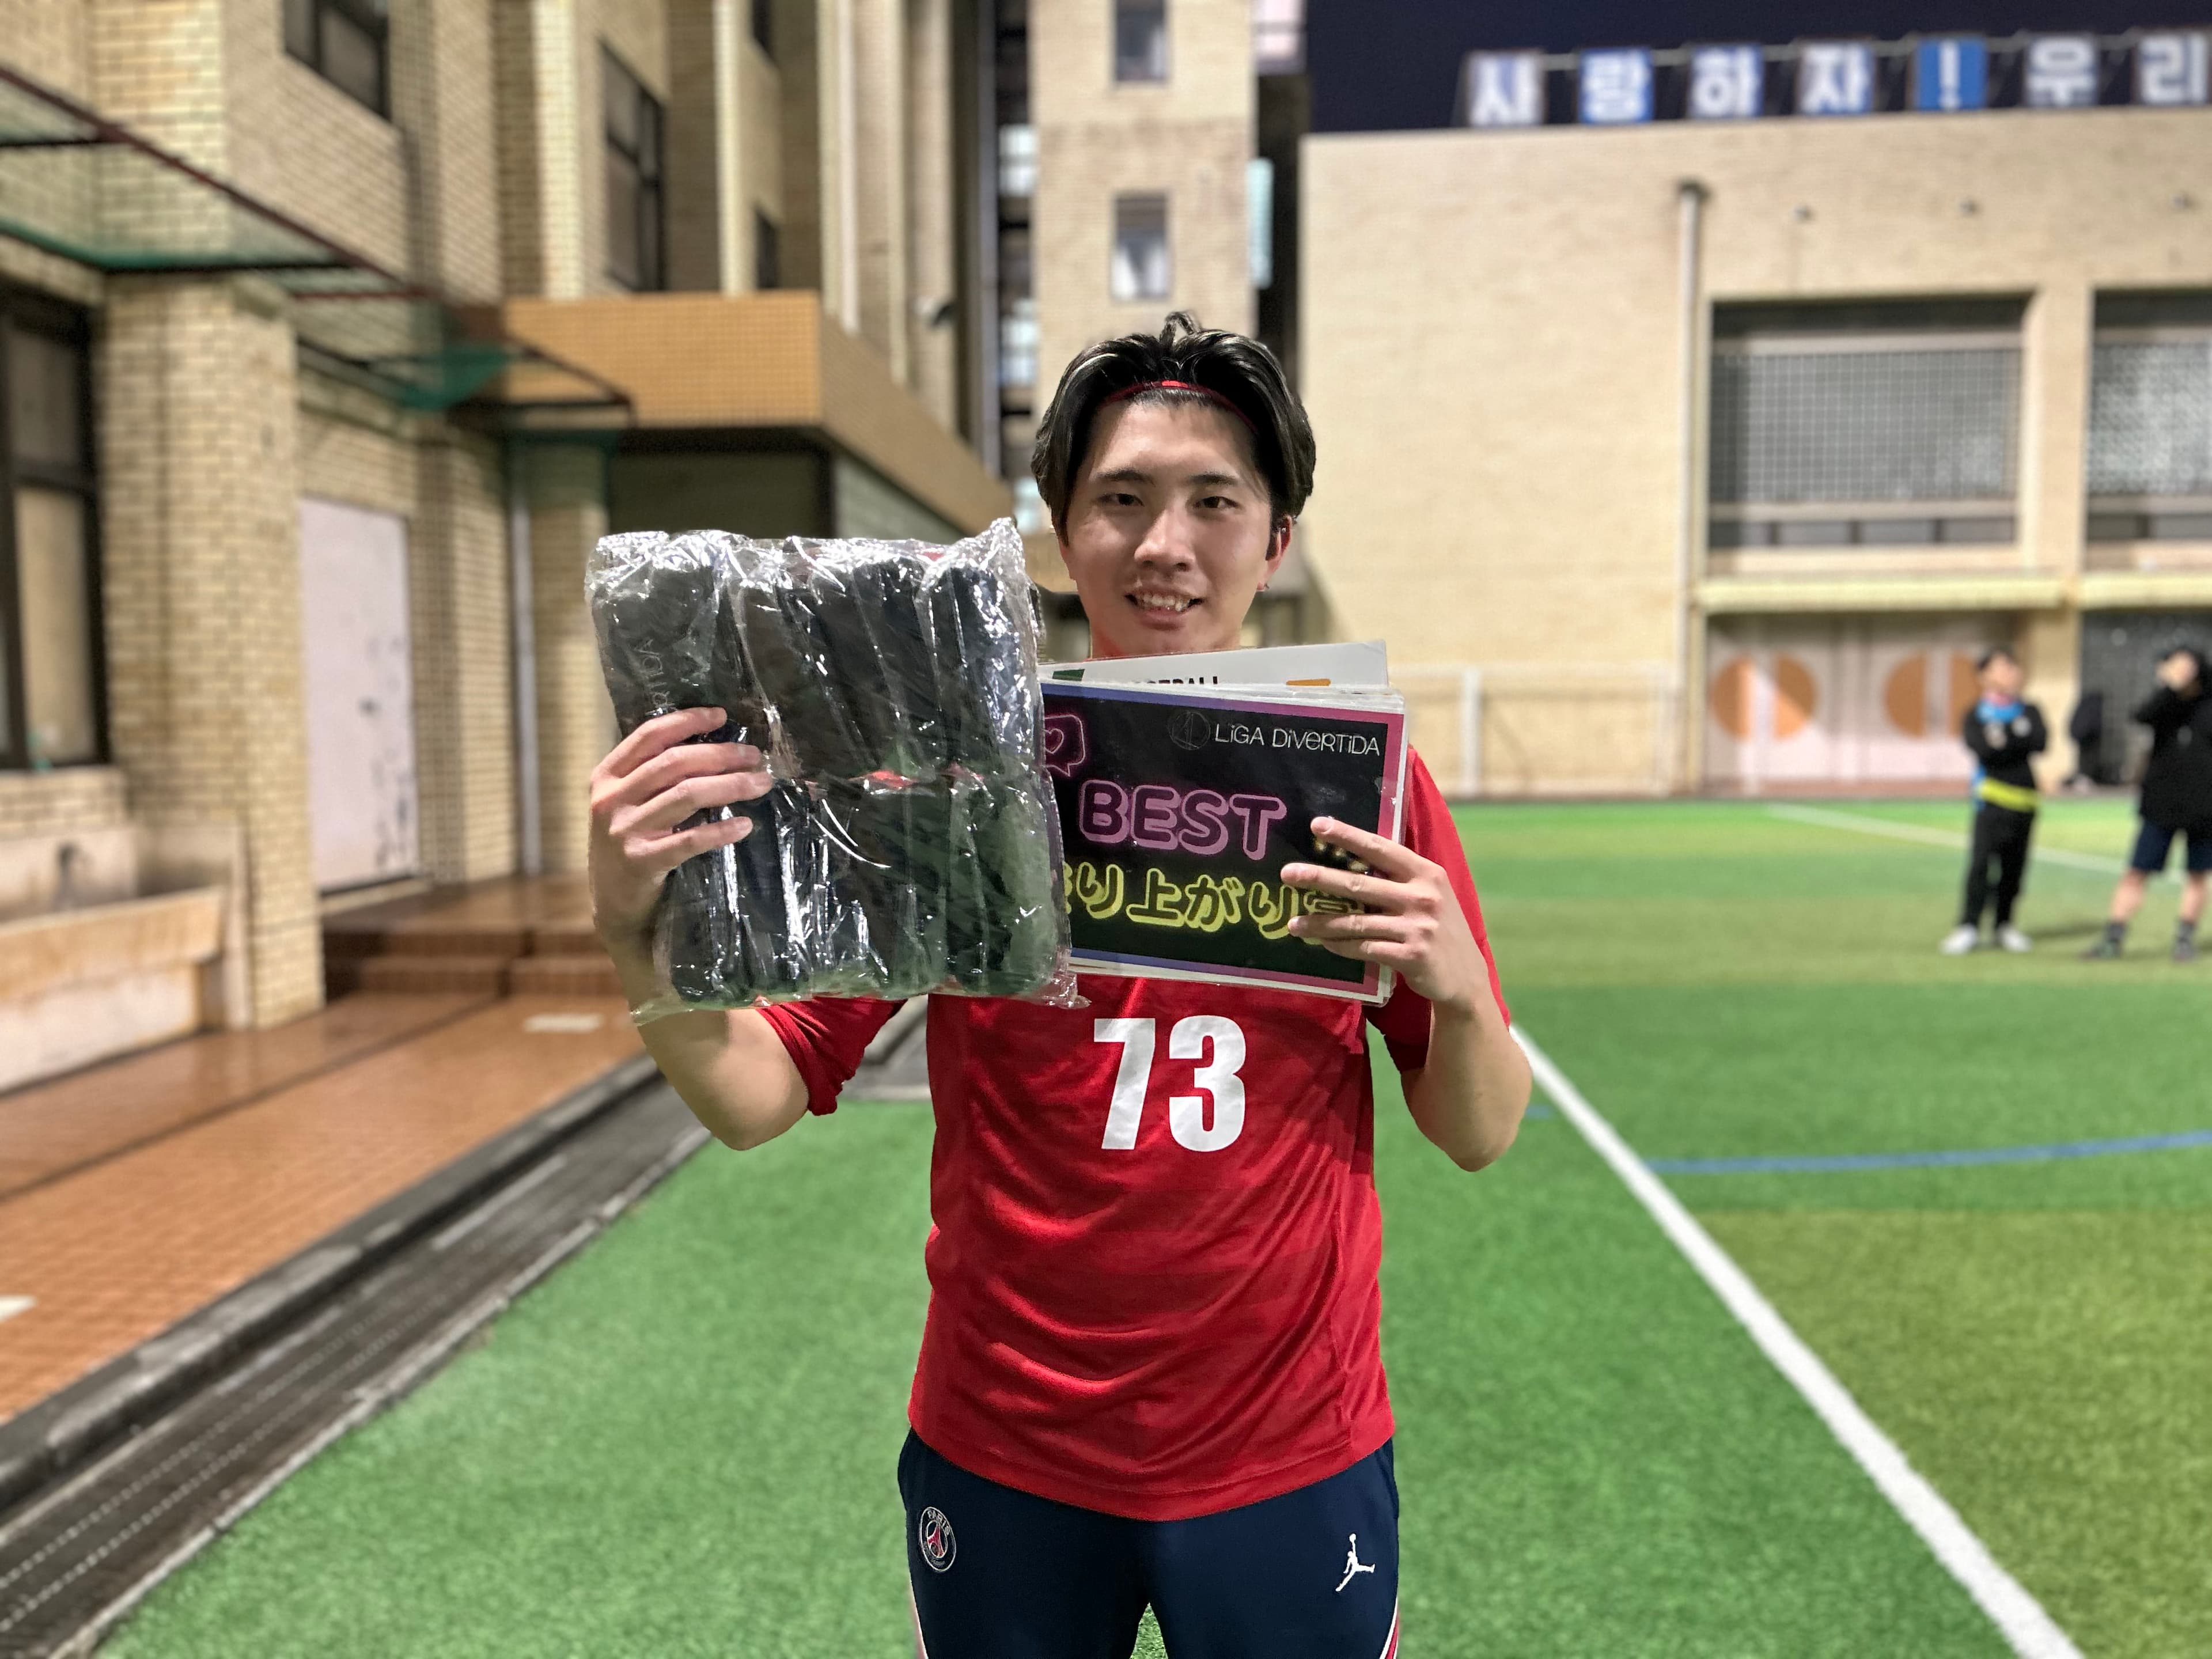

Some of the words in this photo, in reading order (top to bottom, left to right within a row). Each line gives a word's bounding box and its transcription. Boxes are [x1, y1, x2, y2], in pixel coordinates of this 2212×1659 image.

[2025, 34, 2207, 107] 우리
[1078, 779, 1287, 861] BEST
[1063, 861, 1366, 945] り上がり
[1093, 1014, 1247, 1152] 73
[927, 1509, 950, 1536] PARIS
